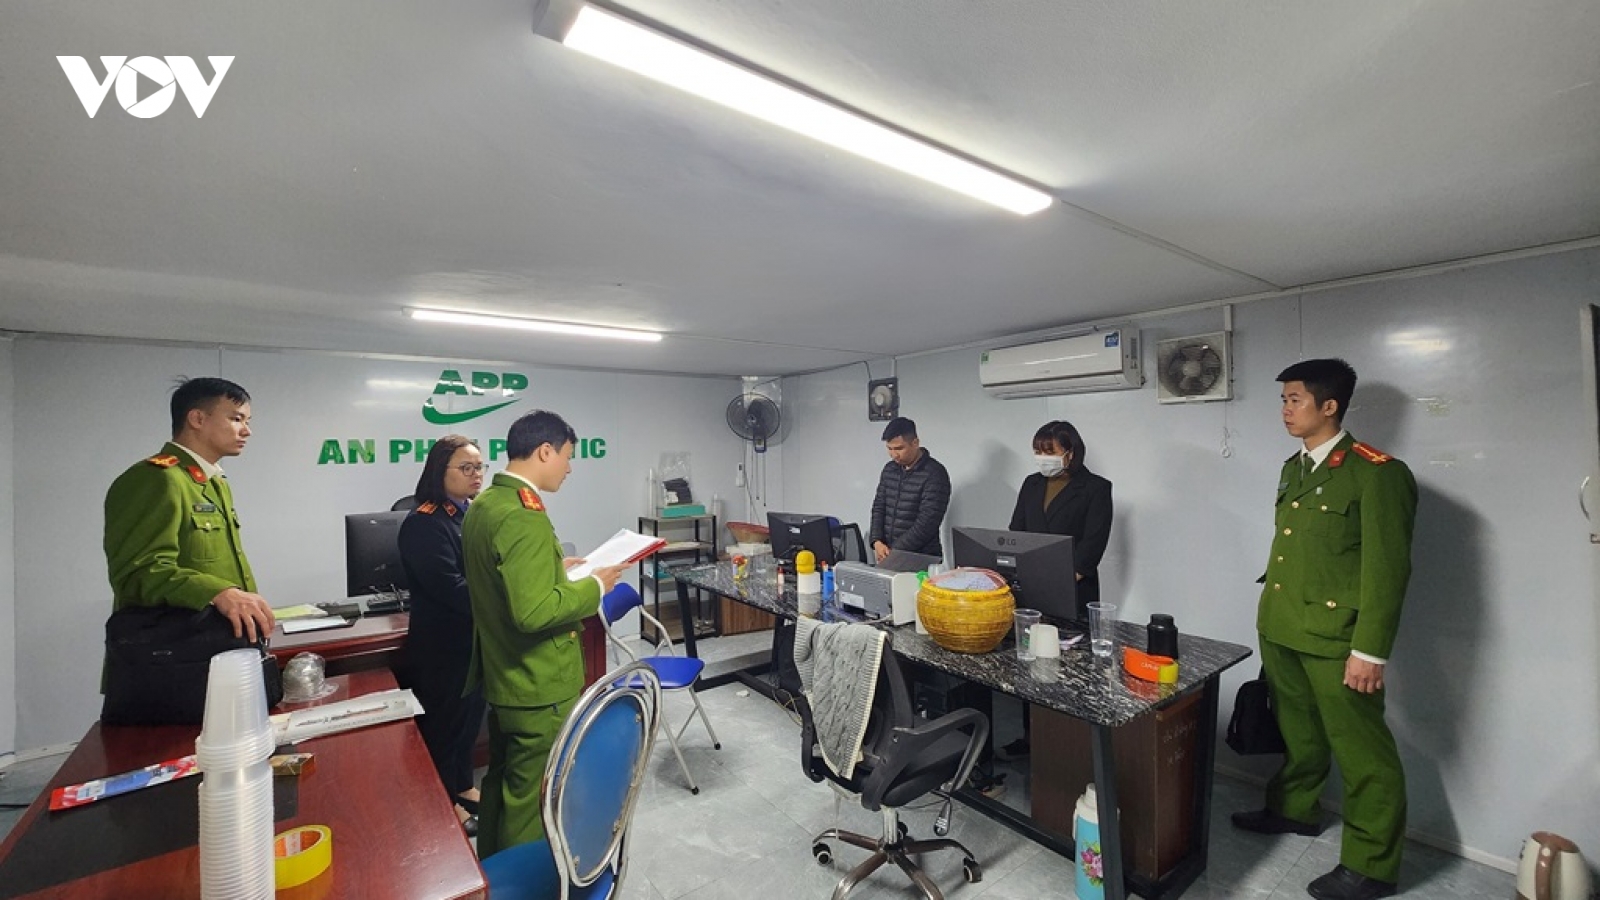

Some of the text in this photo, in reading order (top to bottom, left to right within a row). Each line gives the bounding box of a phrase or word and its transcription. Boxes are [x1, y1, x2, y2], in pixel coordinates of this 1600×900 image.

[432, 370, 528, 397] APP
[318, 439, 375, 465] AN
[389, 438, 479, 463] PH
